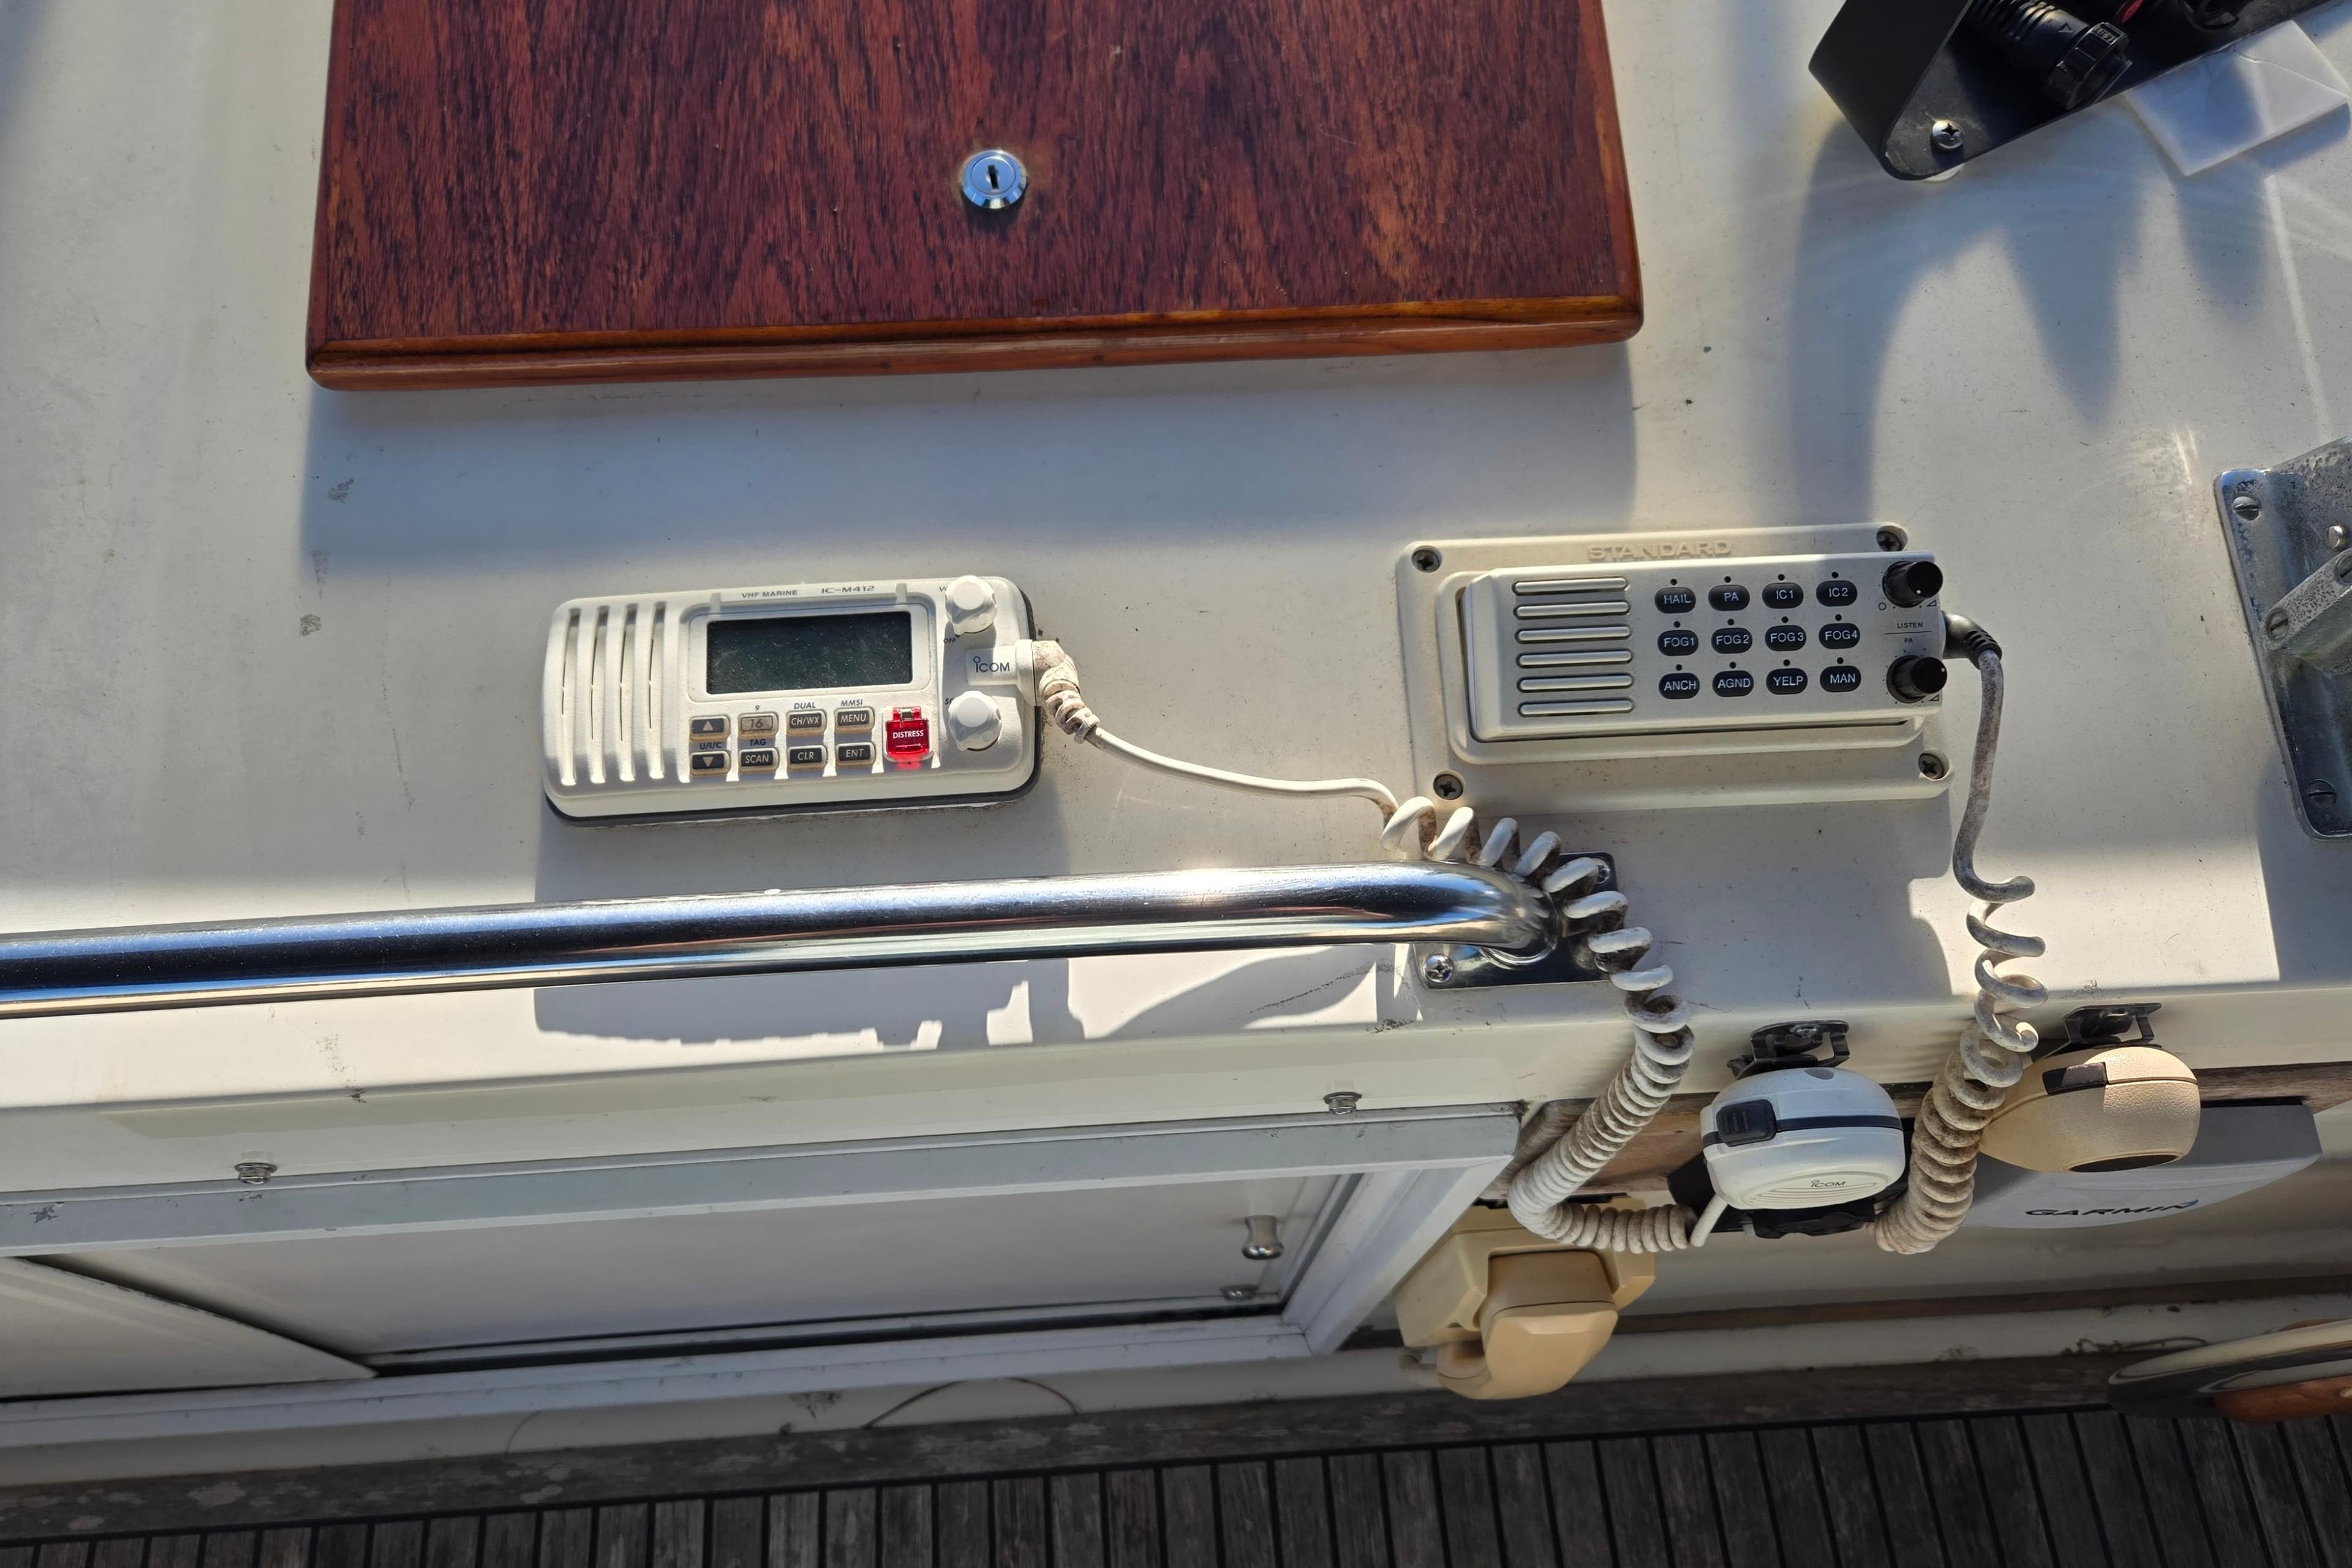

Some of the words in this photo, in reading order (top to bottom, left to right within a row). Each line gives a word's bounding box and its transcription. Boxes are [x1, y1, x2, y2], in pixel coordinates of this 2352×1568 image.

[1587, 540, 1732, 561] STANDARD
[821, 585, 875, 594] IC-M412
[1664, 594, 1691, 605] HAIL
[1724, 592, 1740, 601] PA
[1717, 677, 1751, 688] AGND
[1773, 676, 1804, 687] YELP
[1830, 673, 1856, 684] MAN
[1664, 680, 1697, 692] ANCH
[840, 698, 864, 707] MMSI
[750, 718, 764, 729] 16
[791, 715, 820, 726] CH/WX
[840, 713, 867, 723] MENU
[892, 729, 924, 739] DISTRESS
[797, 751, 815, 761] CLR
[845, 748, 864, 758] ENT
[745, 754, 769, 764] SCAN
[2024, 1199, 2199, 1216] GARMIN
